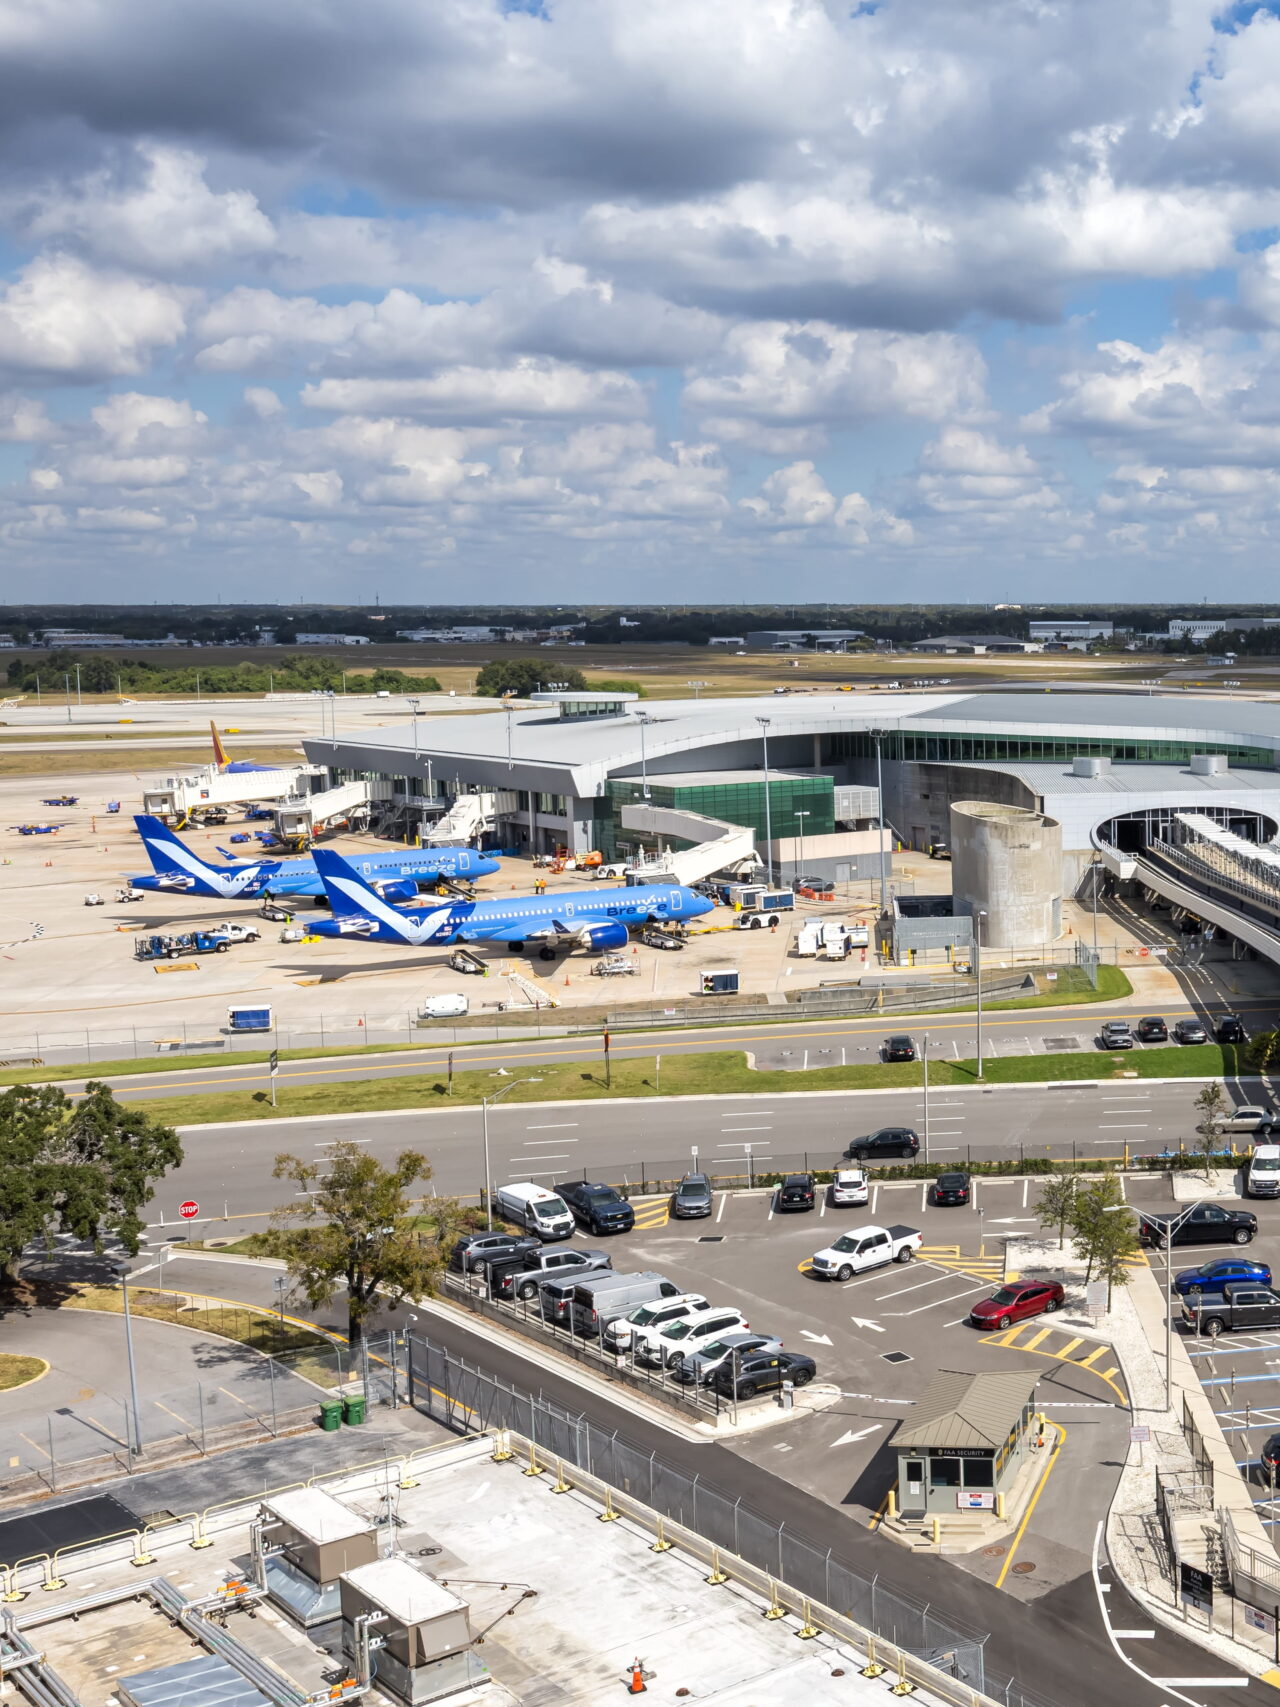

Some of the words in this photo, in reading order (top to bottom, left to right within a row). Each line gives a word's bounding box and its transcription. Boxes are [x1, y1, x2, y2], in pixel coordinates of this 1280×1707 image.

[400, 863, 456, 875] Breeze
[607, 903, 667, 917] Breeze
[180, 1205, 198, 1214] STOP
